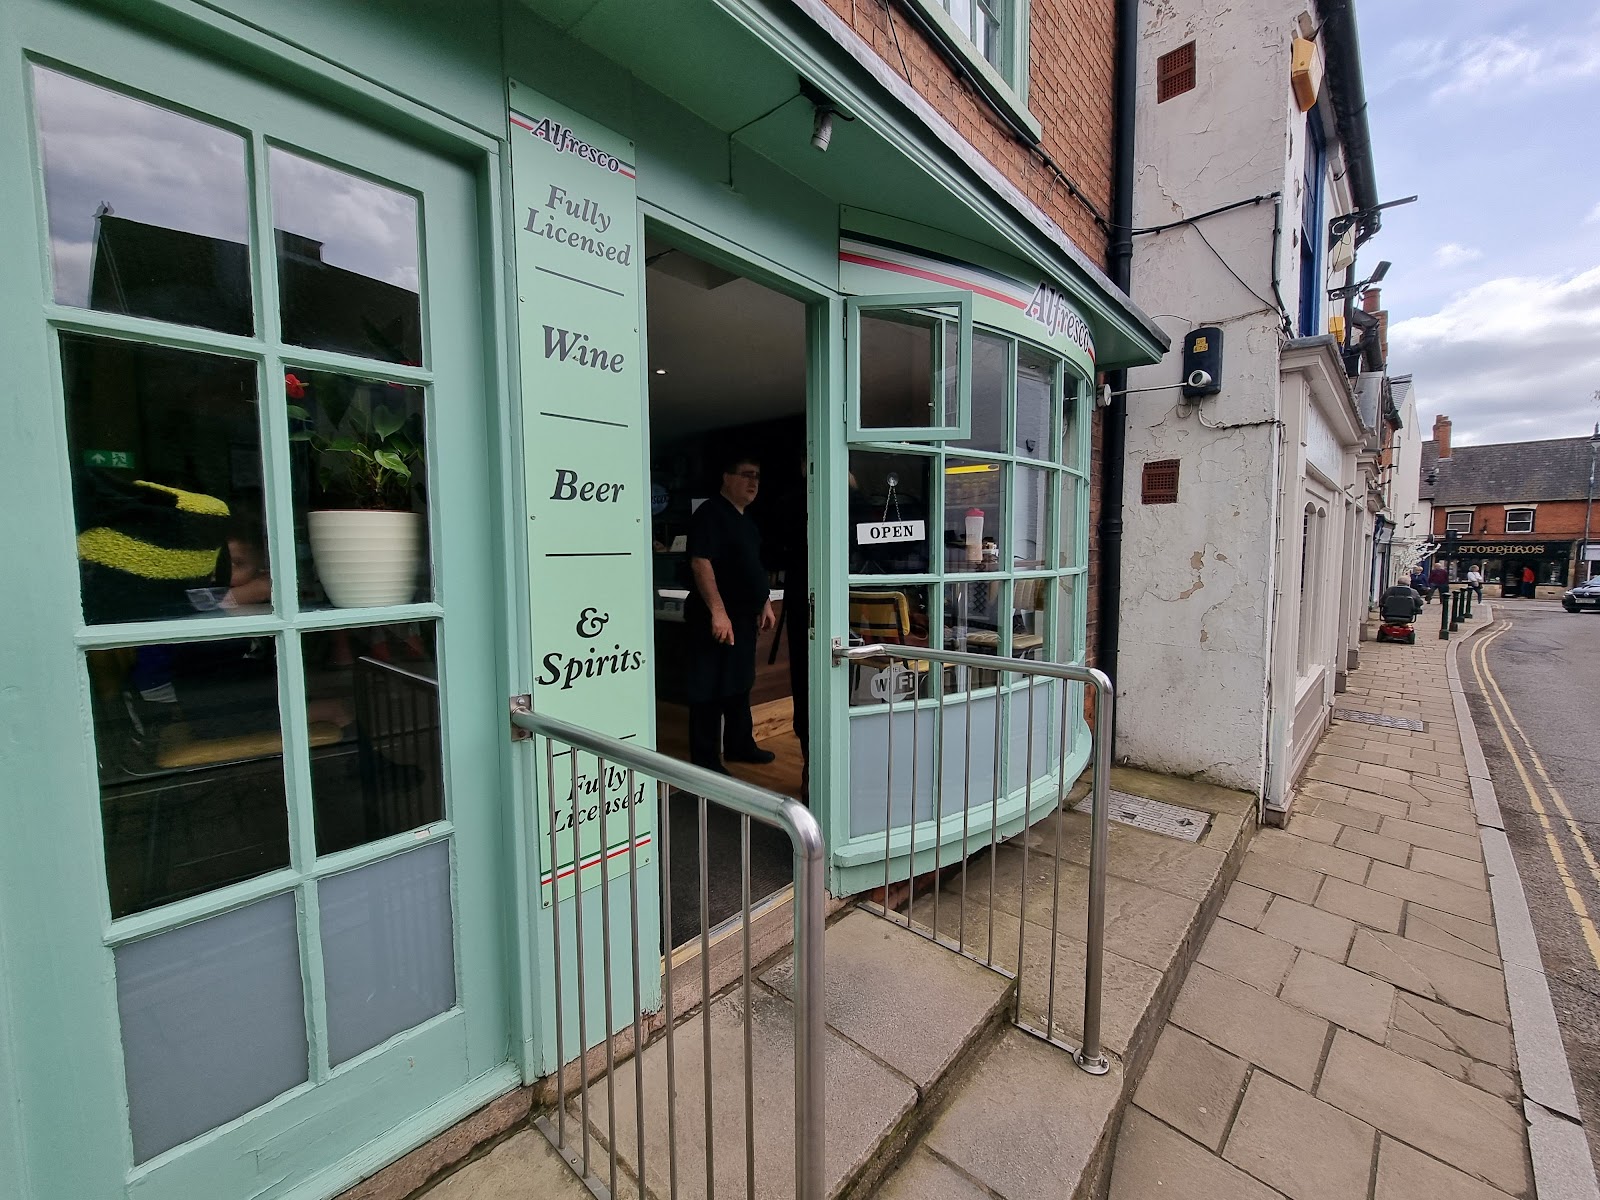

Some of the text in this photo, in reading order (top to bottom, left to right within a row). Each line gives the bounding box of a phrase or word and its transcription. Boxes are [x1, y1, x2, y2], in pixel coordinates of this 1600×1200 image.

[532, 118, 620, 172] Alfresco
[545, 184, 611, 233] Fully
[524, 207, 631, 266] Licensed
[1025, 282, 1089, 352] Alfresco
[542, 324, 625, 374] Wine
[550, 469, 624, 503] Beer
[870, 525, 914, 539] OPEN
[576, 607, 609, 638] &
[538, 643, 642, 690] Spirits
